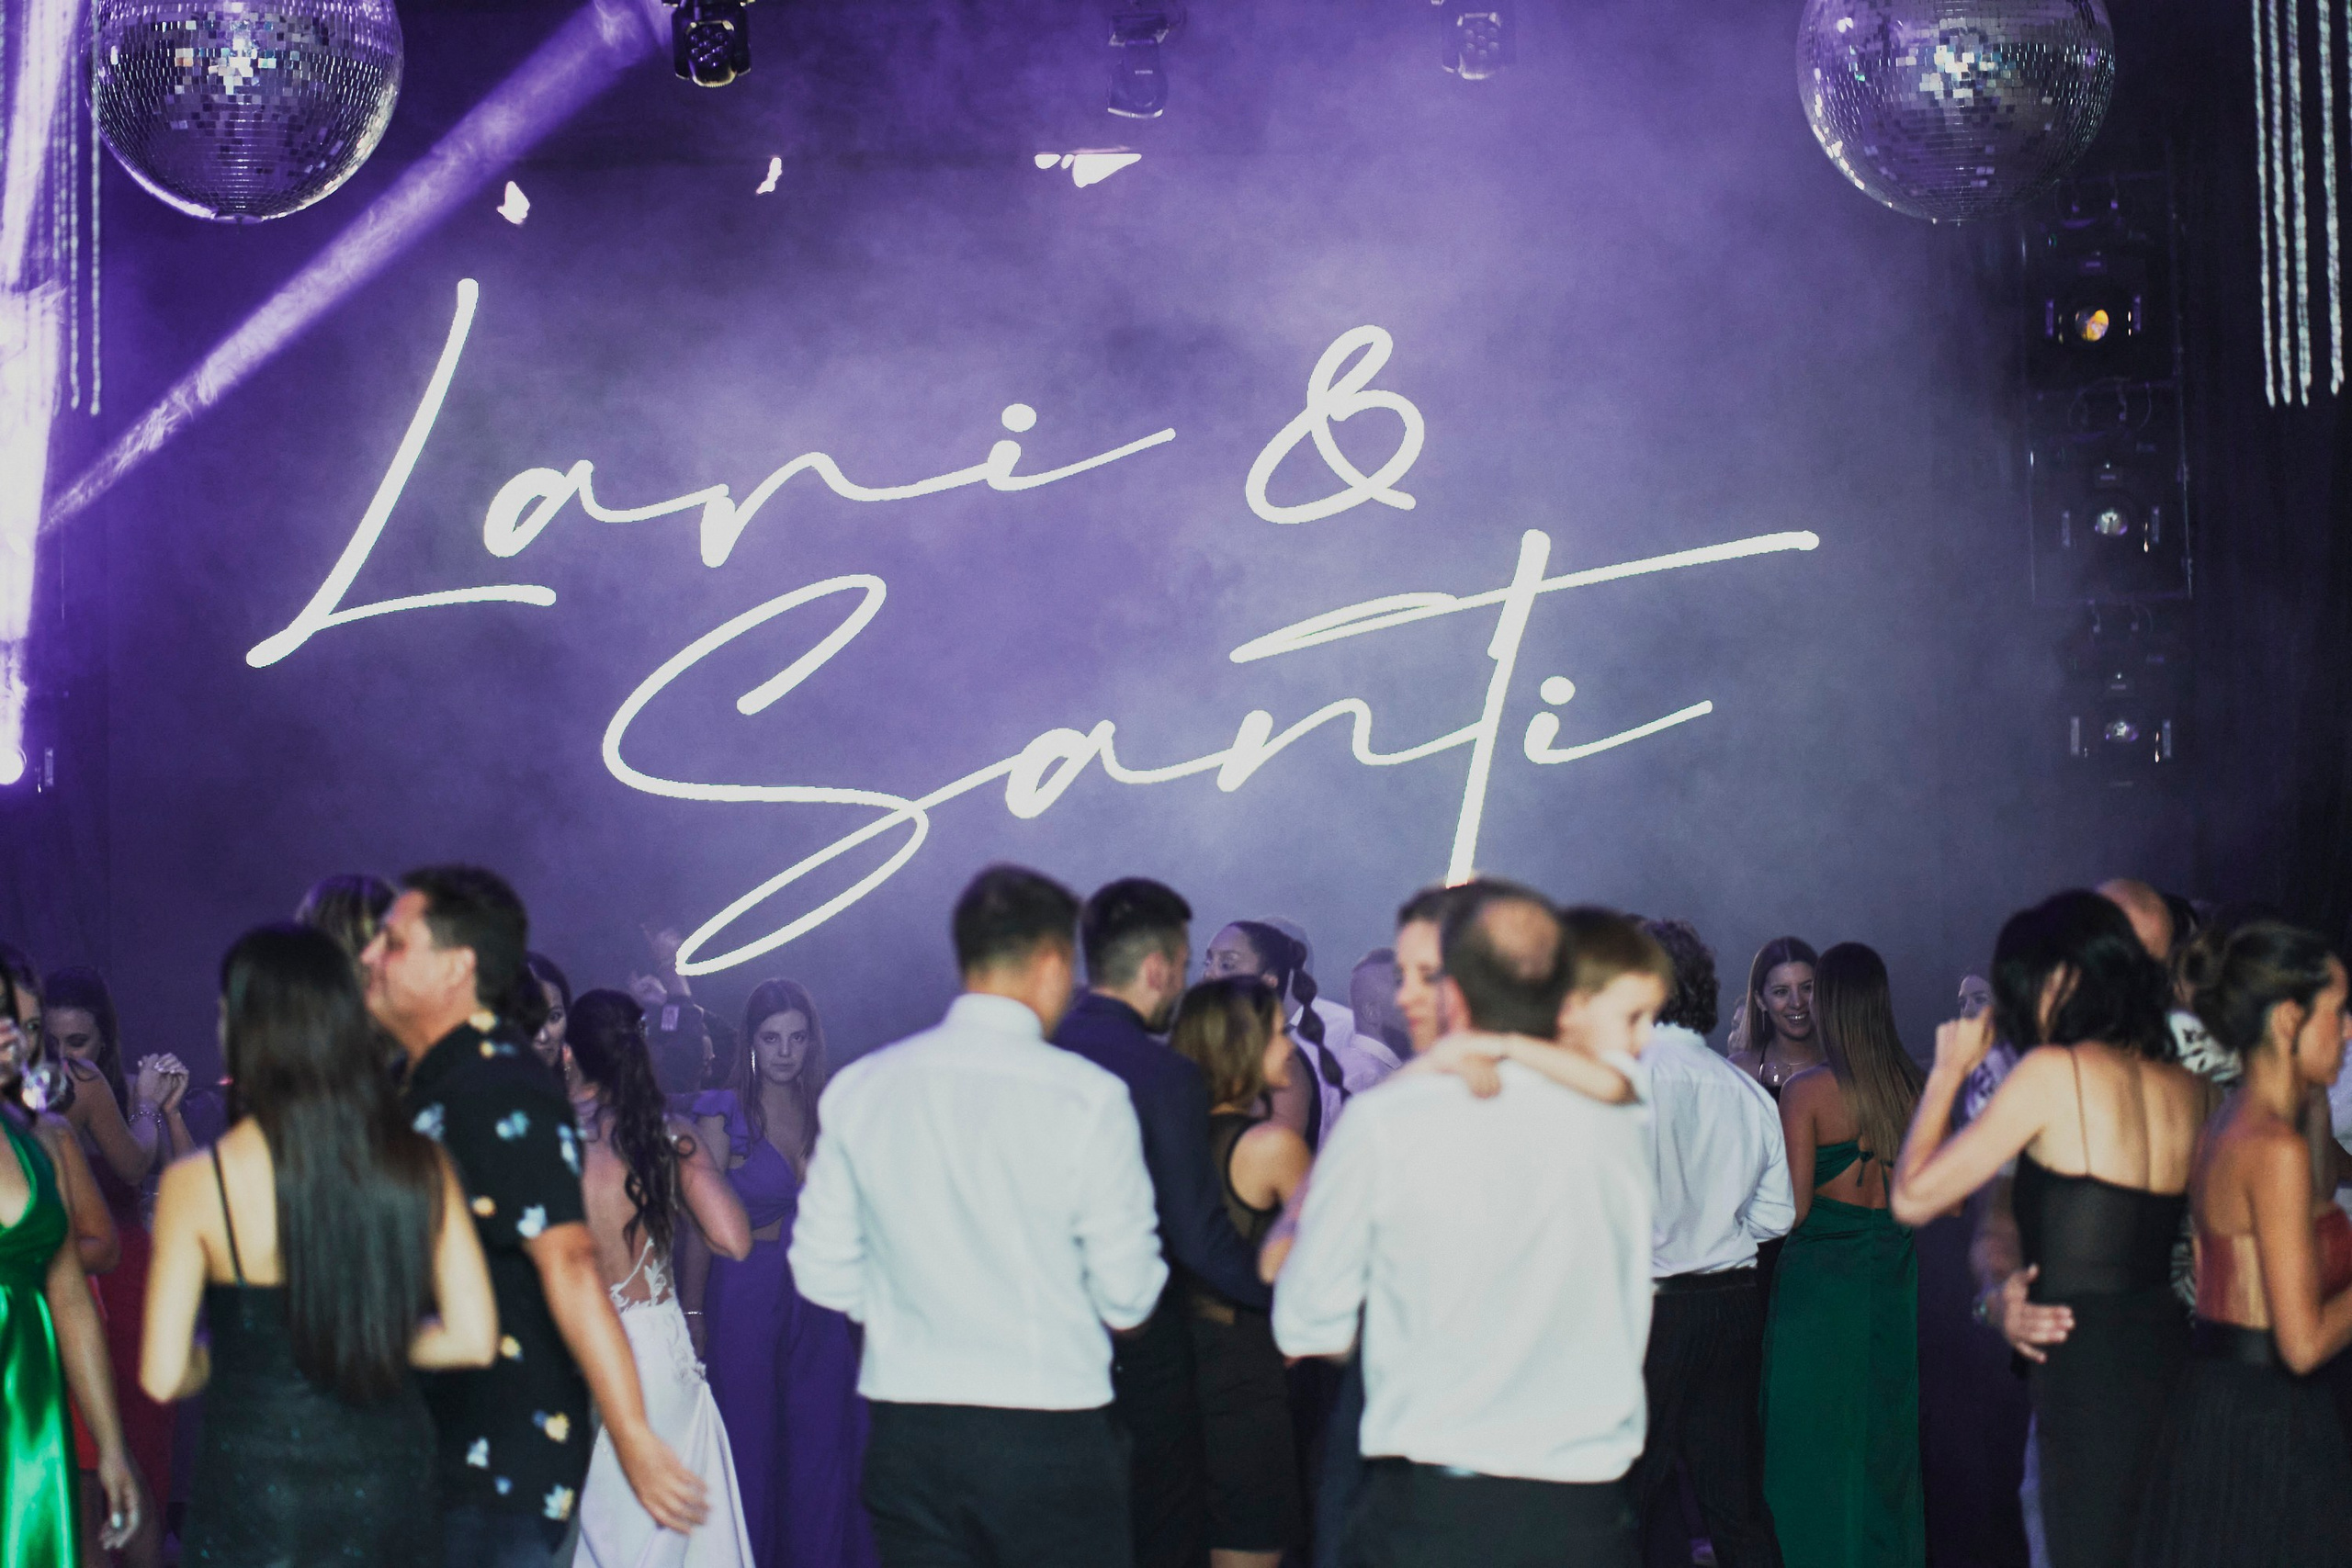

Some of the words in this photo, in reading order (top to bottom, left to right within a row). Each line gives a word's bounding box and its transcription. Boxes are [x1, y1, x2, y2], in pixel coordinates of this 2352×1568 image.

[245, 277, 1177, 669] Lani
[1244, 324, 1425, 525] &
[602, 528, 1820, 976] Santi
